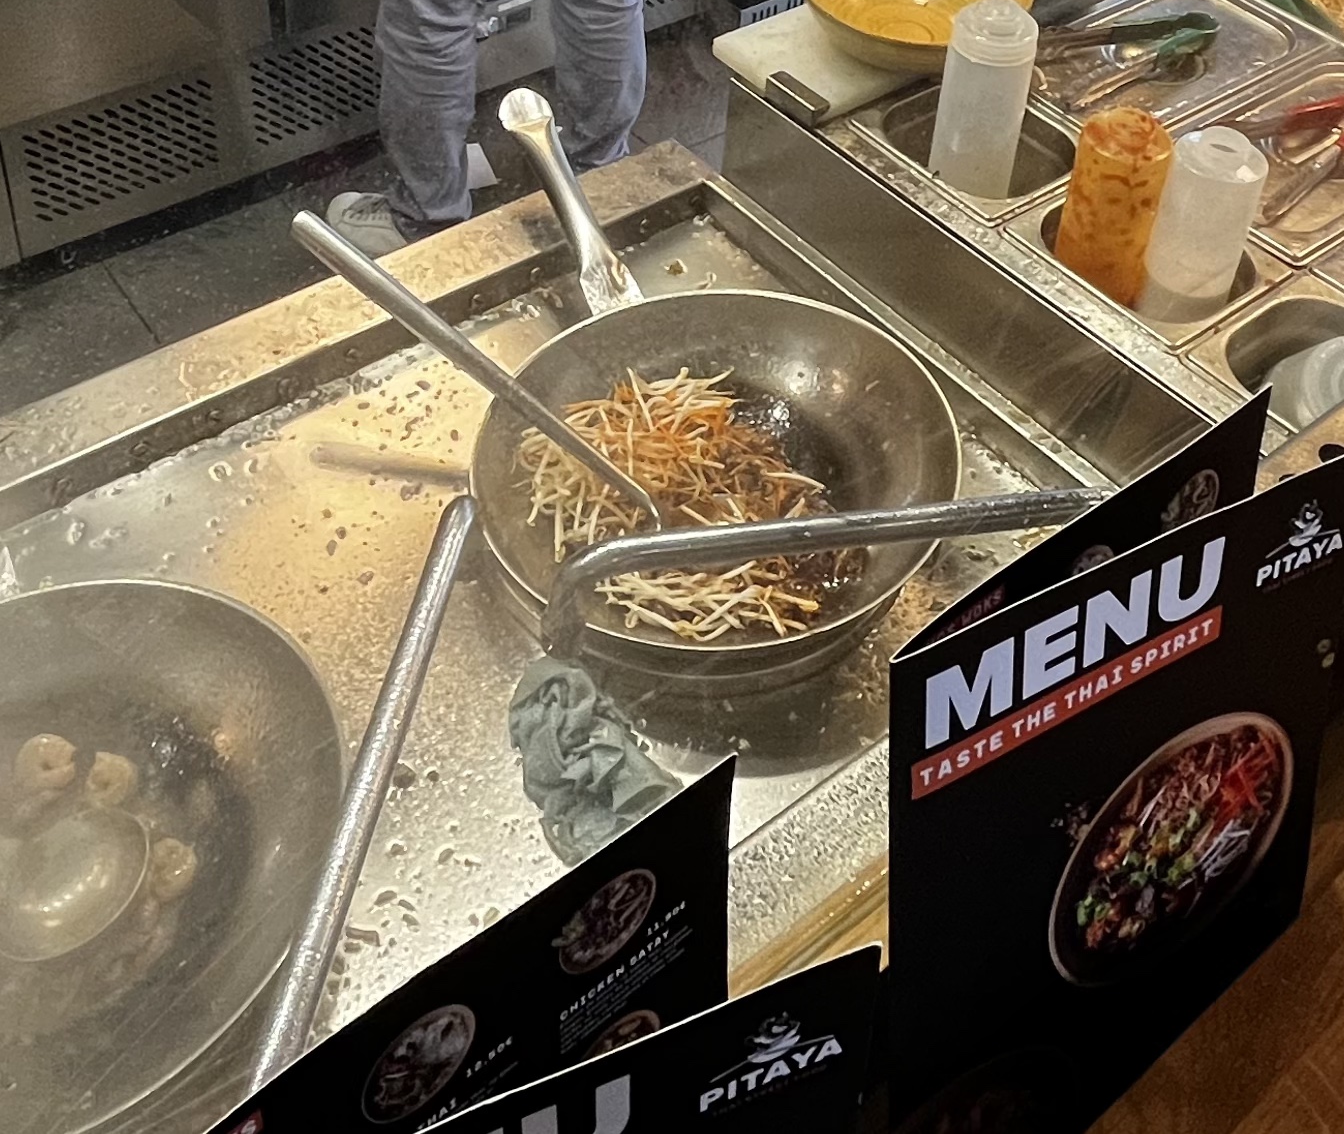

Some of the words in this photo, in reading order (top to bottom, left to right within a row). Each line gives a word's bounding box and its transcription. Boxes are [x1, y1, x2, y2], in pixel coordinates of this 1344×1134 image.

[1256, 533, 1343, 587] PITAYA
[919, 730, 1004, 787] TASTE
[1011, 701, 1057, 738] THE
[1063, 665, 1123, 710] THAI
[1130, 618, 1215, 675] SPIRIT
[925, 536, 1226, 750] MENU
[699, 1037, 843, 1113] PITAYA
